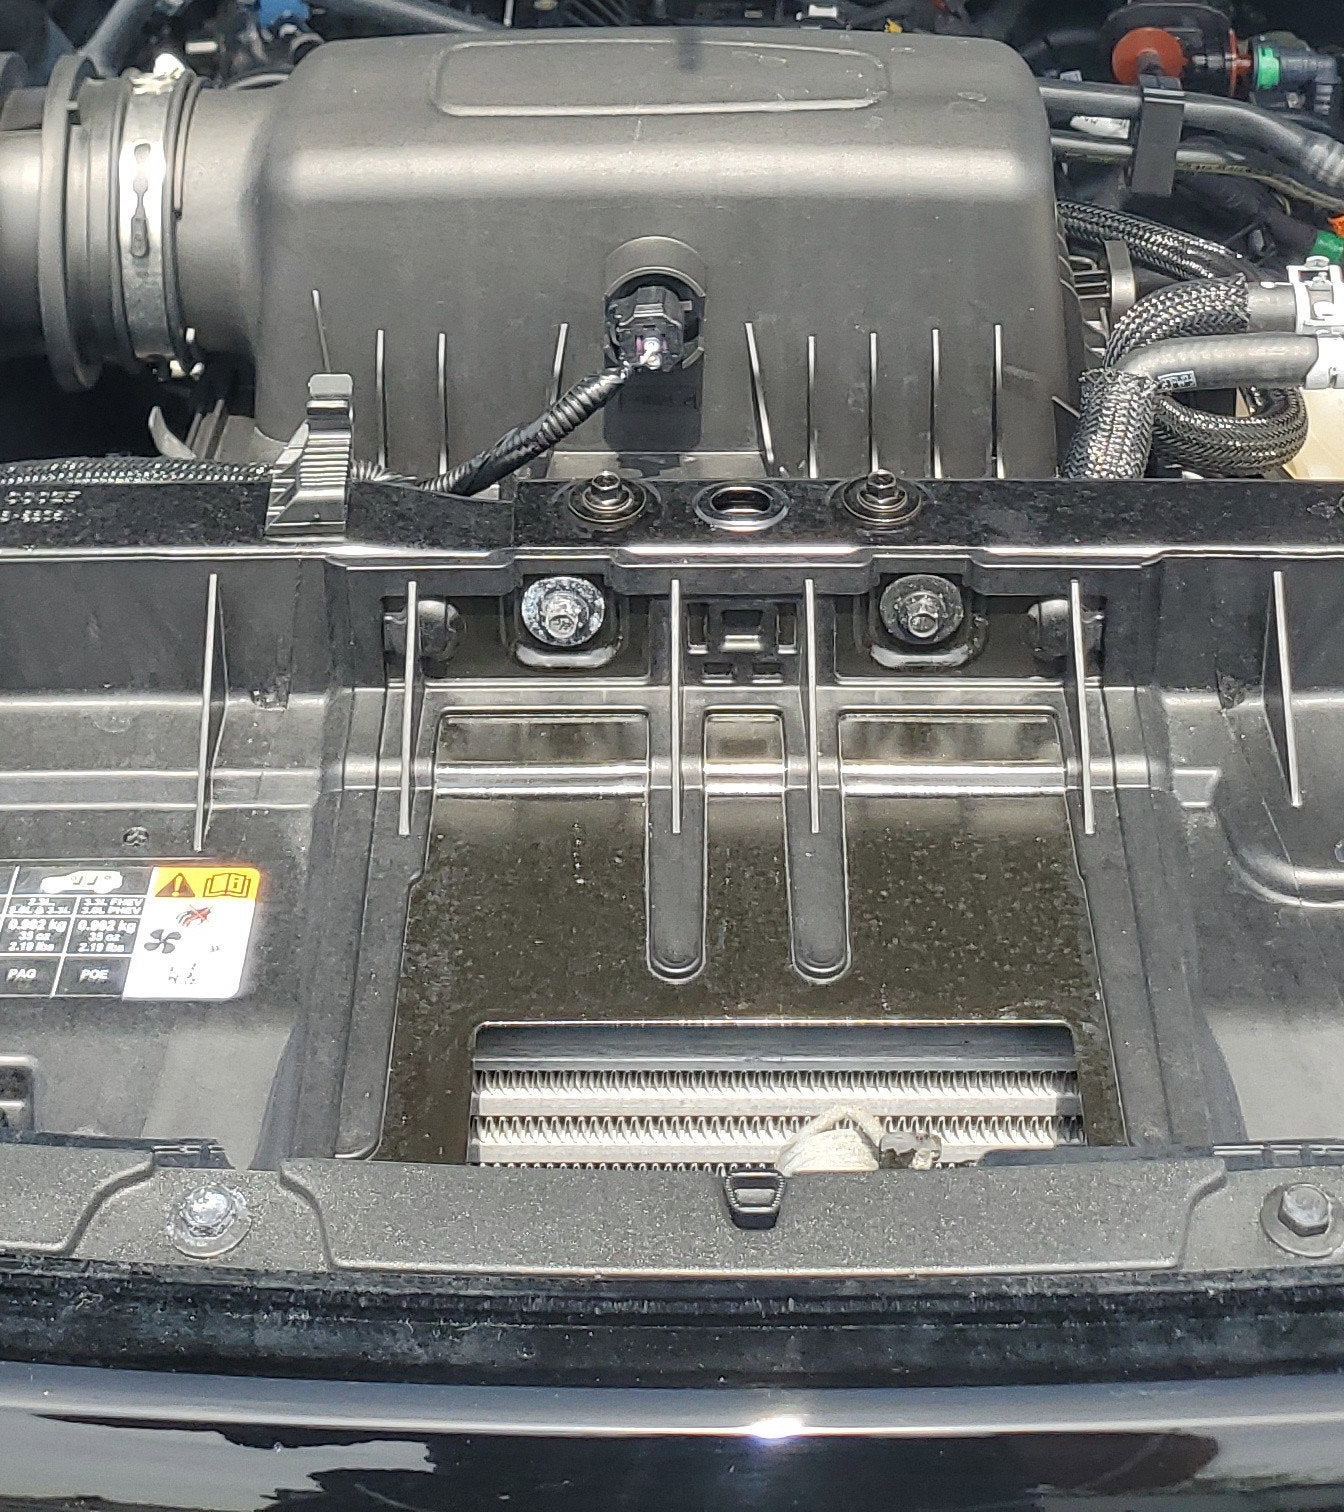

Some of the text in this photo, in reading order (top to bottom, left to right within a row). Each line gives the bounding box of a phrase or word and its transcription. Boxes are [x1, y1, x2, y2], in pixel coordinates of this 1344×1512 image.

[48, 919, 67, 932] kg
[118, 920, 137, 934] kg
[106, 933, 121, 941] oz
[8, 969, 37, 979] PAG
[80, 969, 109, 980] POE
